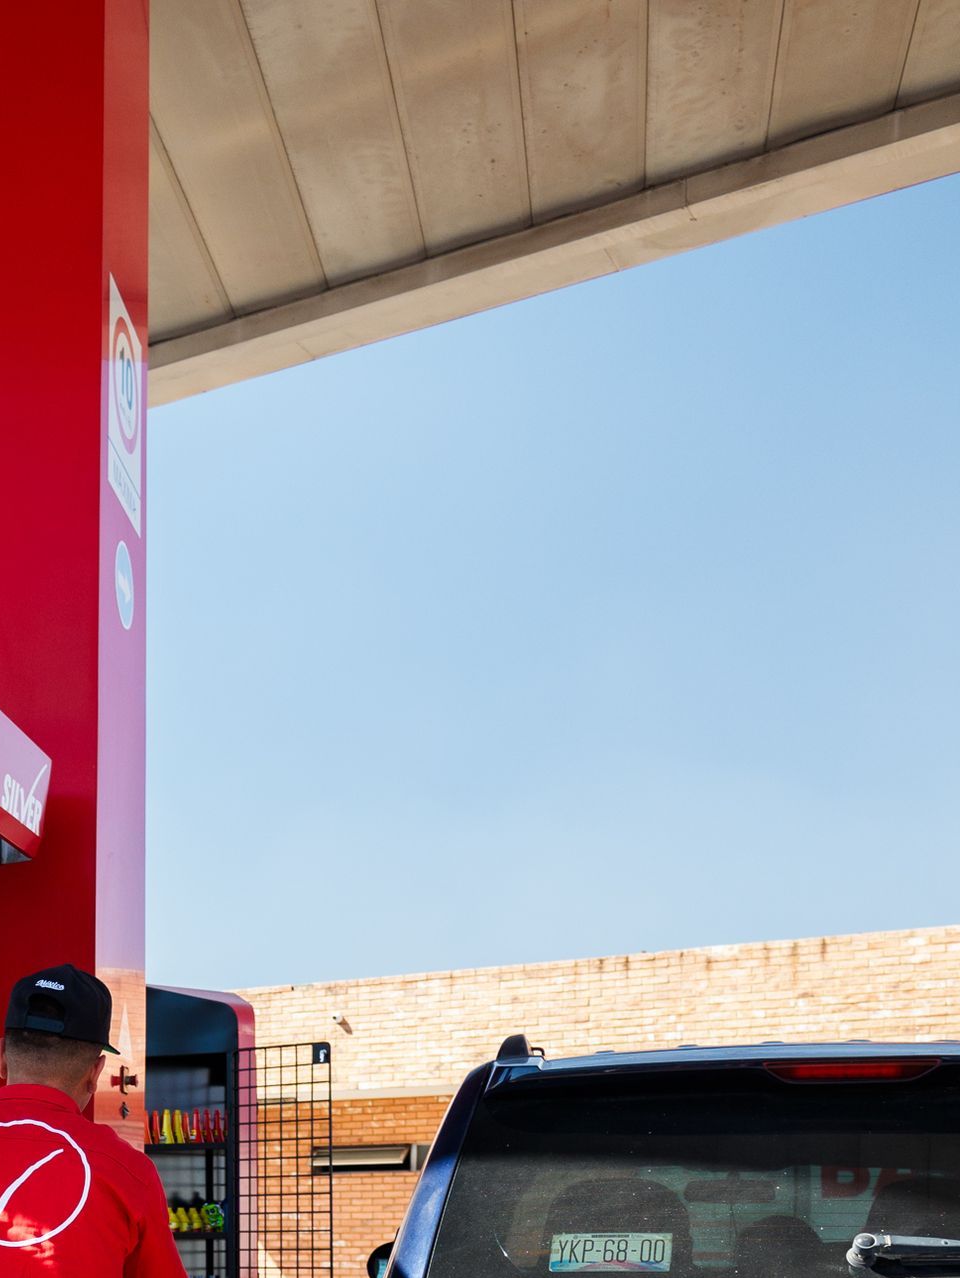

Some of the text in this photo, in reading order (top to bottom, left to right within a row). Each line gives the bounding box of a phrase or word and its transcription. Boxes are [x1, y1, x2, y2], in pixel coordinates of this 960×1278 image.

[119, 347, 133, 410] 10
[1, 764, 48, 837] SILVER
[559, 1239, 666, 1264] YKP-68-00
